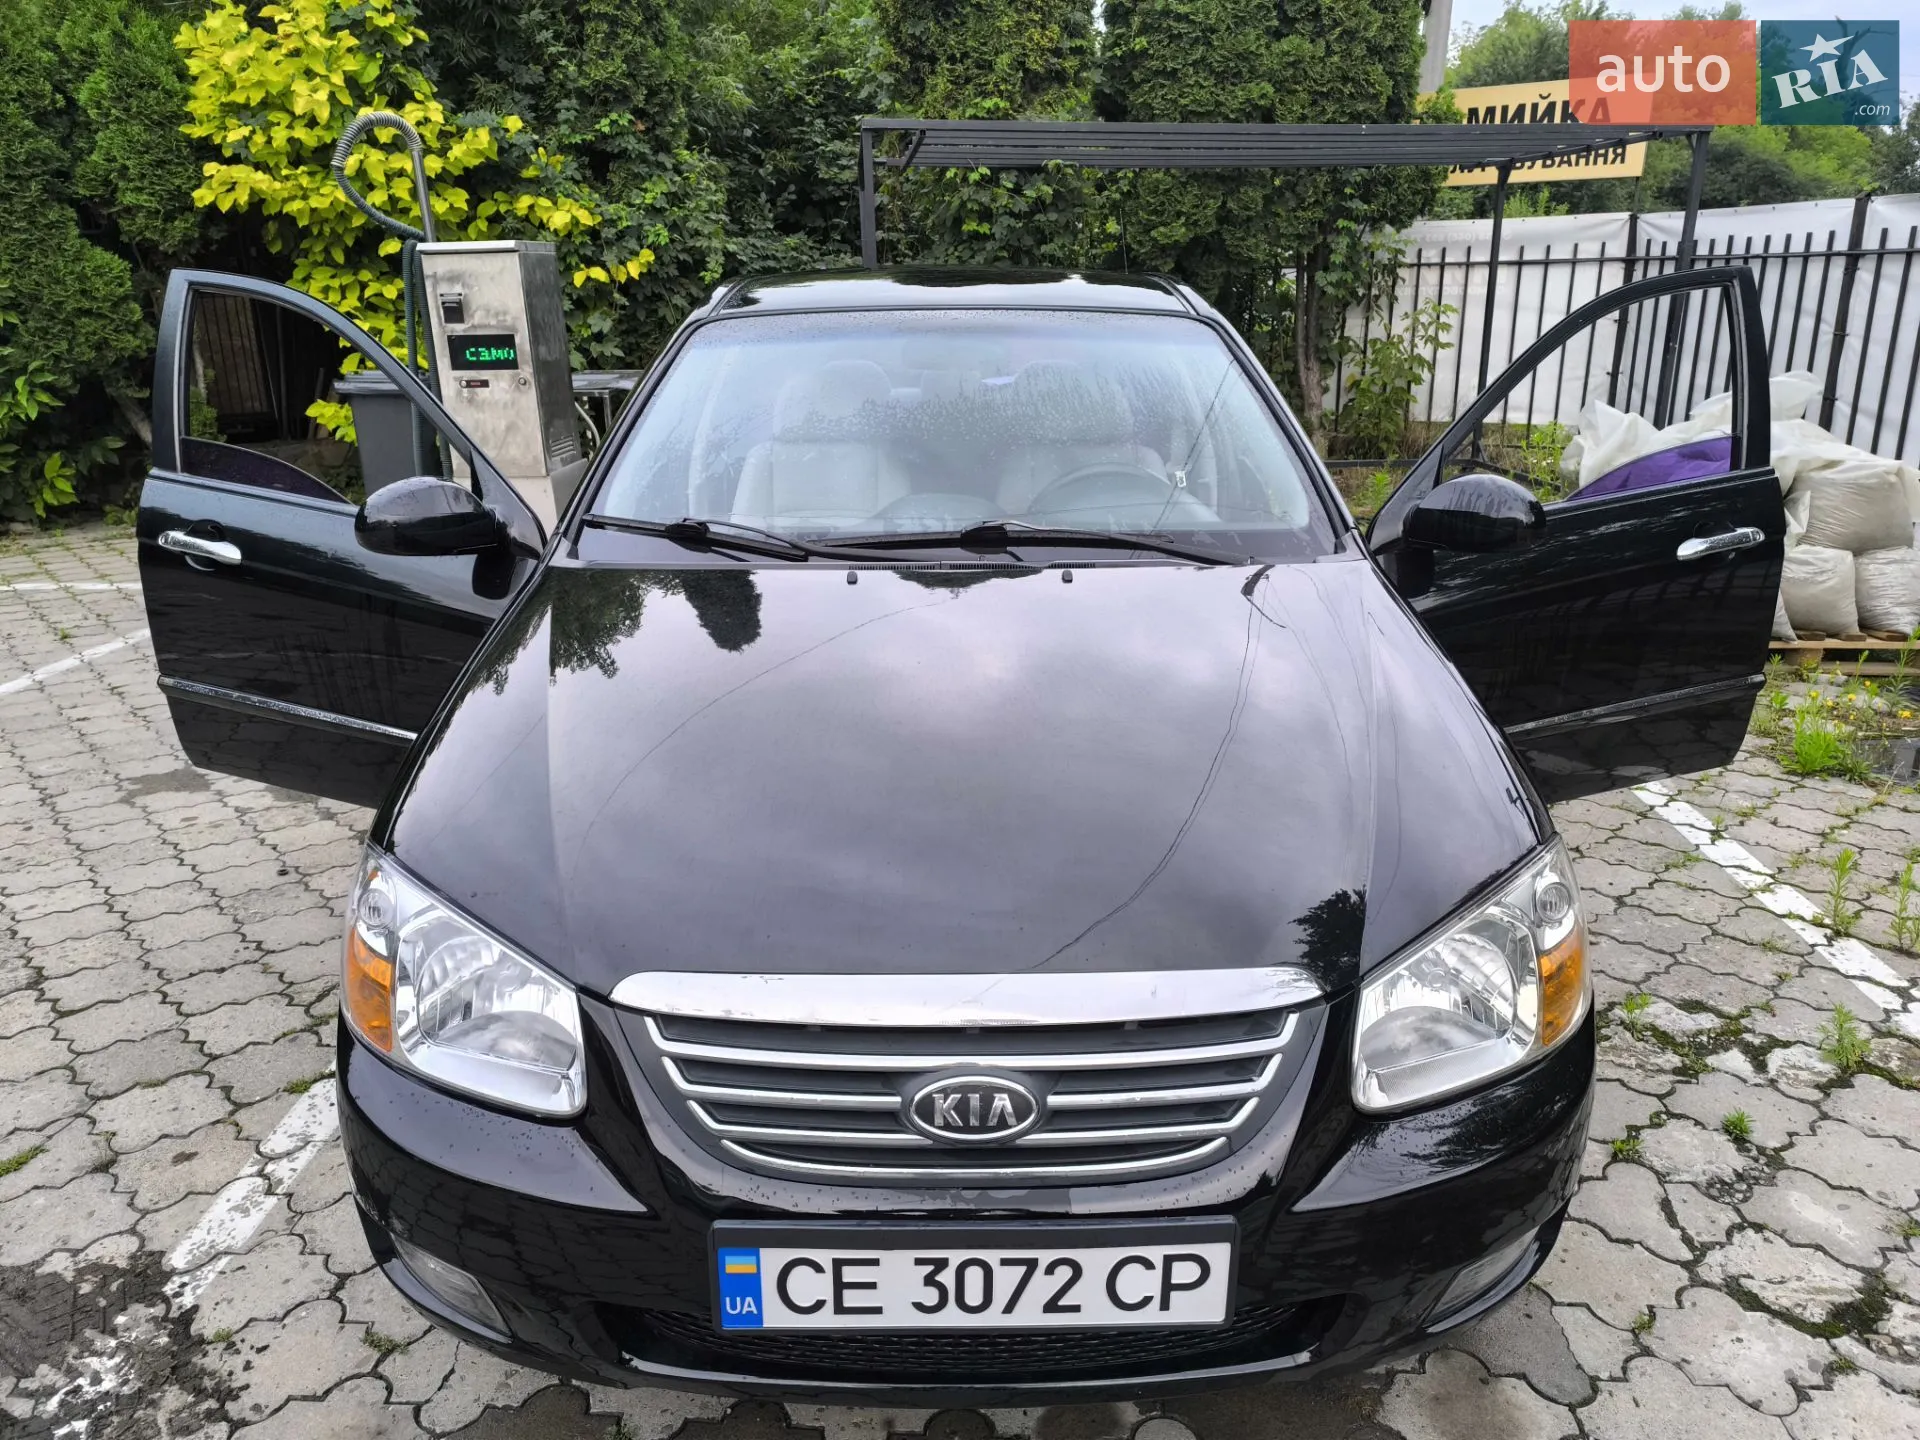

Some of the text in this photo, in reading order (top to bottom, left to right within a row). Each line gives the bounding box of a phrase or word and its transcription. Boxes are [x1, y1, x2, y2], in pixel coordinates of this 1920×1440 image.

[931, 1093, 1019, 1127] KIA
[775, 1252, 1212, 1316] CE 3072 CP
[725, 1296, 758, 1316] UA
